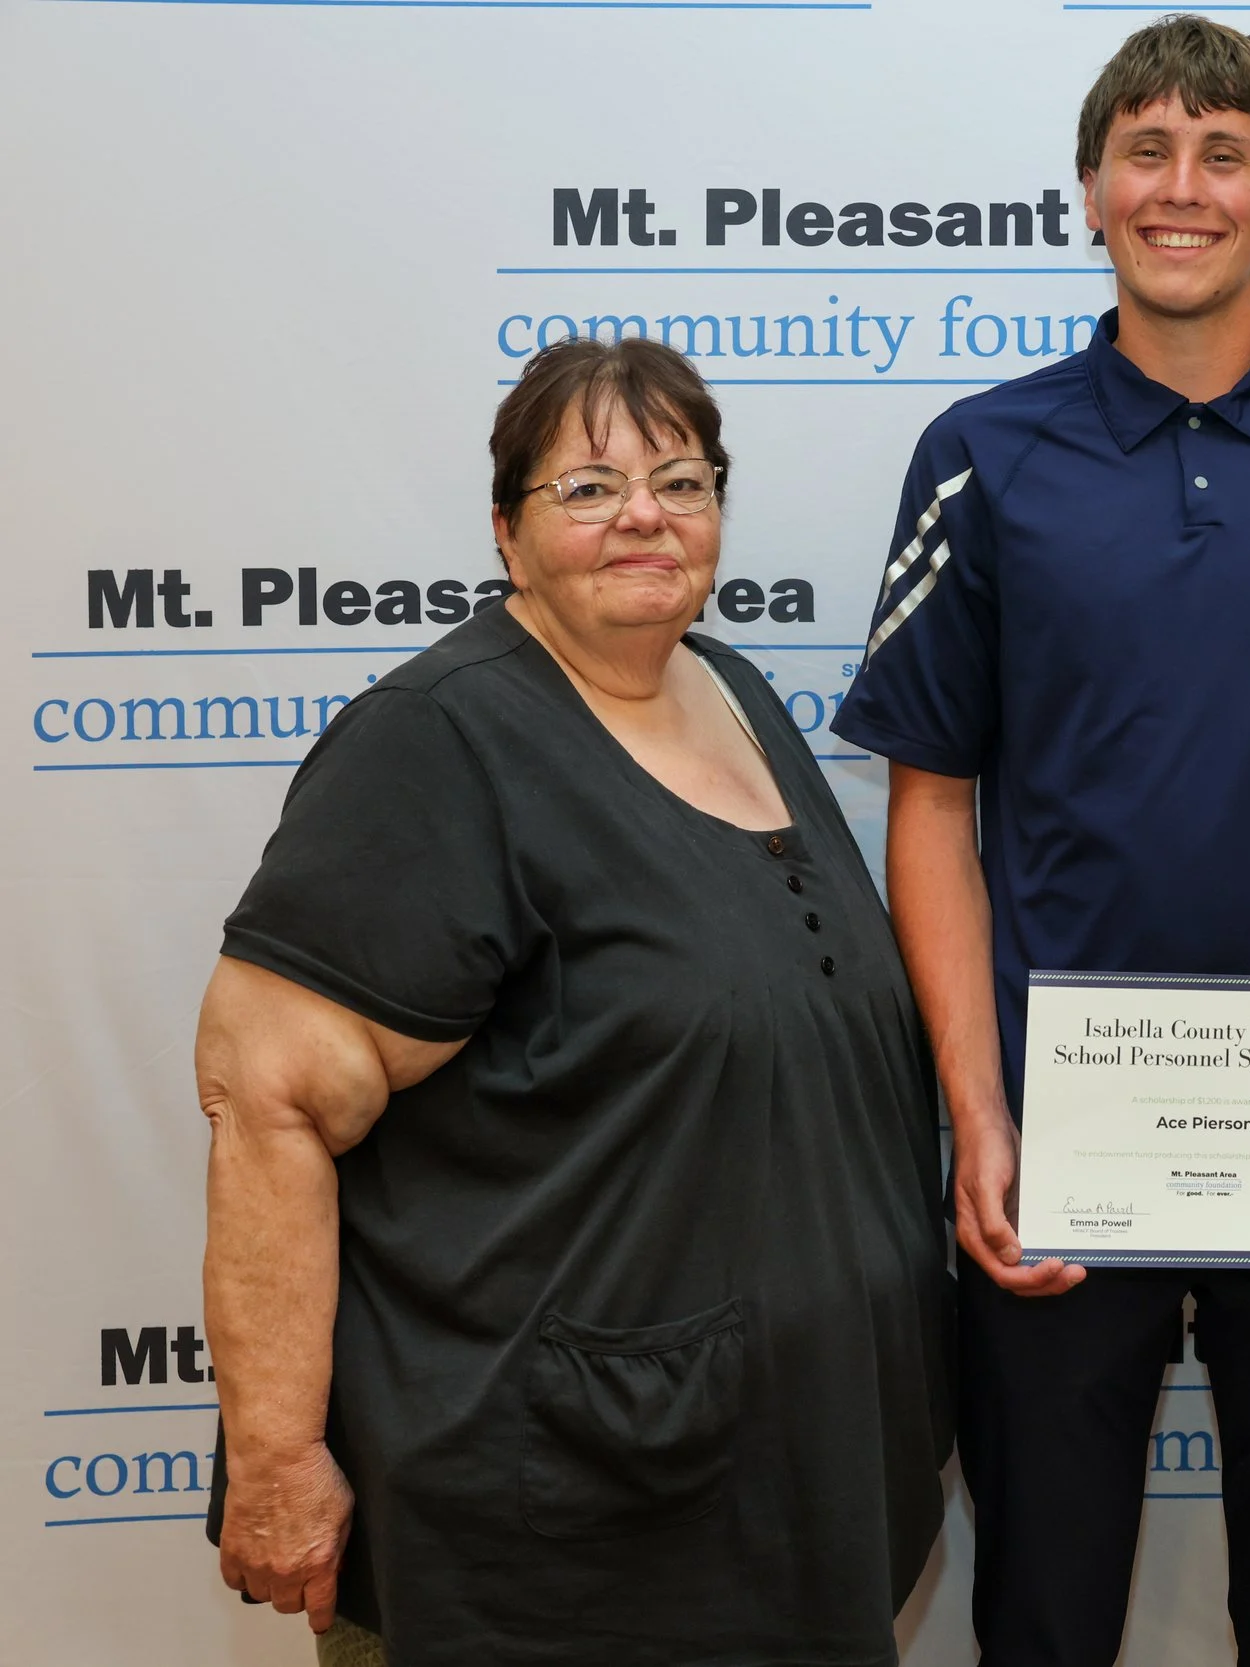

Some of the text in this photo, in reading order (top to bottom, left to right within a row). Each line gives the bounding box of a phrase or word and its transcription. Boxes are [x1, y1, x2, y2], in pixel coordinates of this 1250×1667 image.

[553, 188, 1069, 247] Mt. Pleasant
[88, 568, 213, 628] Mt.
[692, 578, 815, 623] ea
[1084, 1017, 1164, 1040] Isabella
[1170, 1020, 1246, 1046] County
[1053, 1045, 1121, 1066] School
[1129, 1047, 1230, 1068] Personnel
[1131, 1096, 1138, 1104] A
[1139, 1096, 1186, 1105] scholarship
[1187, 1096, 1196, 1104] of
[1156, 1116, 1187, 1130] Ace
[1166, 1180, 1242, 1189] community foundation
[1070, 1219, 1132, 1227] Emma Powell
